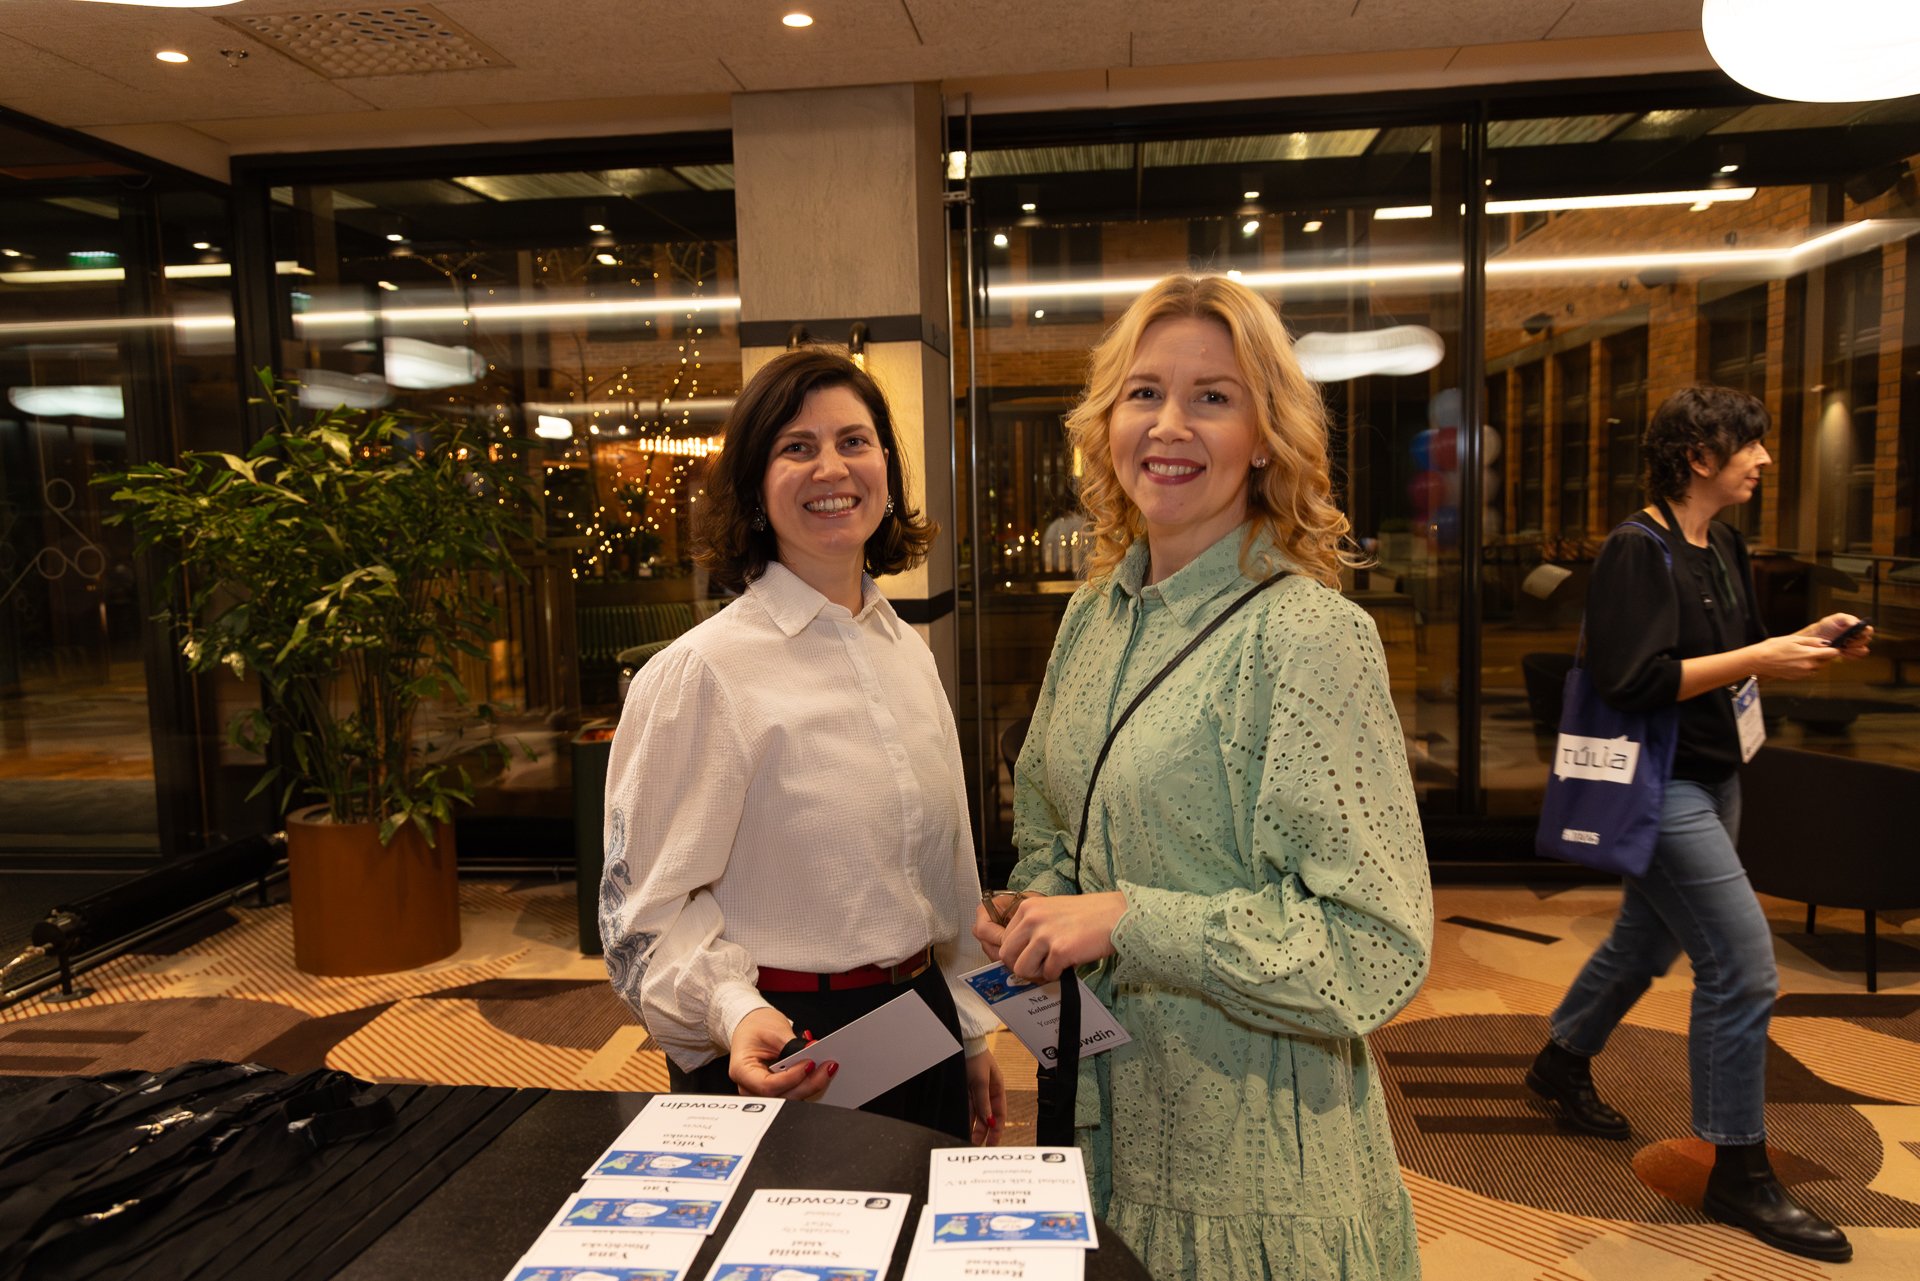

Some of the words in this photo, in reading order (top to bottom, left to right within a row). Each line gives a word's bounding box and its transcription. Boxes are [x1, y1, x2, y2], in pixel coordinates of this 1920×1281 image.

[1028, 994, 1049, 1005] Nea
[1080, 1029, 1116, 1048] wdin
[660, 1102, 739, 1111] crowdin
[946, 1154, 1036, 1164] crowdin
[767, 1196, 859, 1206] crowdin
[991, 1197, 1028, 1206] Rick
[588, 1251, 629, 1260] Yana
[767, 1248, 842, 1259] Svanhild
[964, 1267, 1025, 1278] Renata
